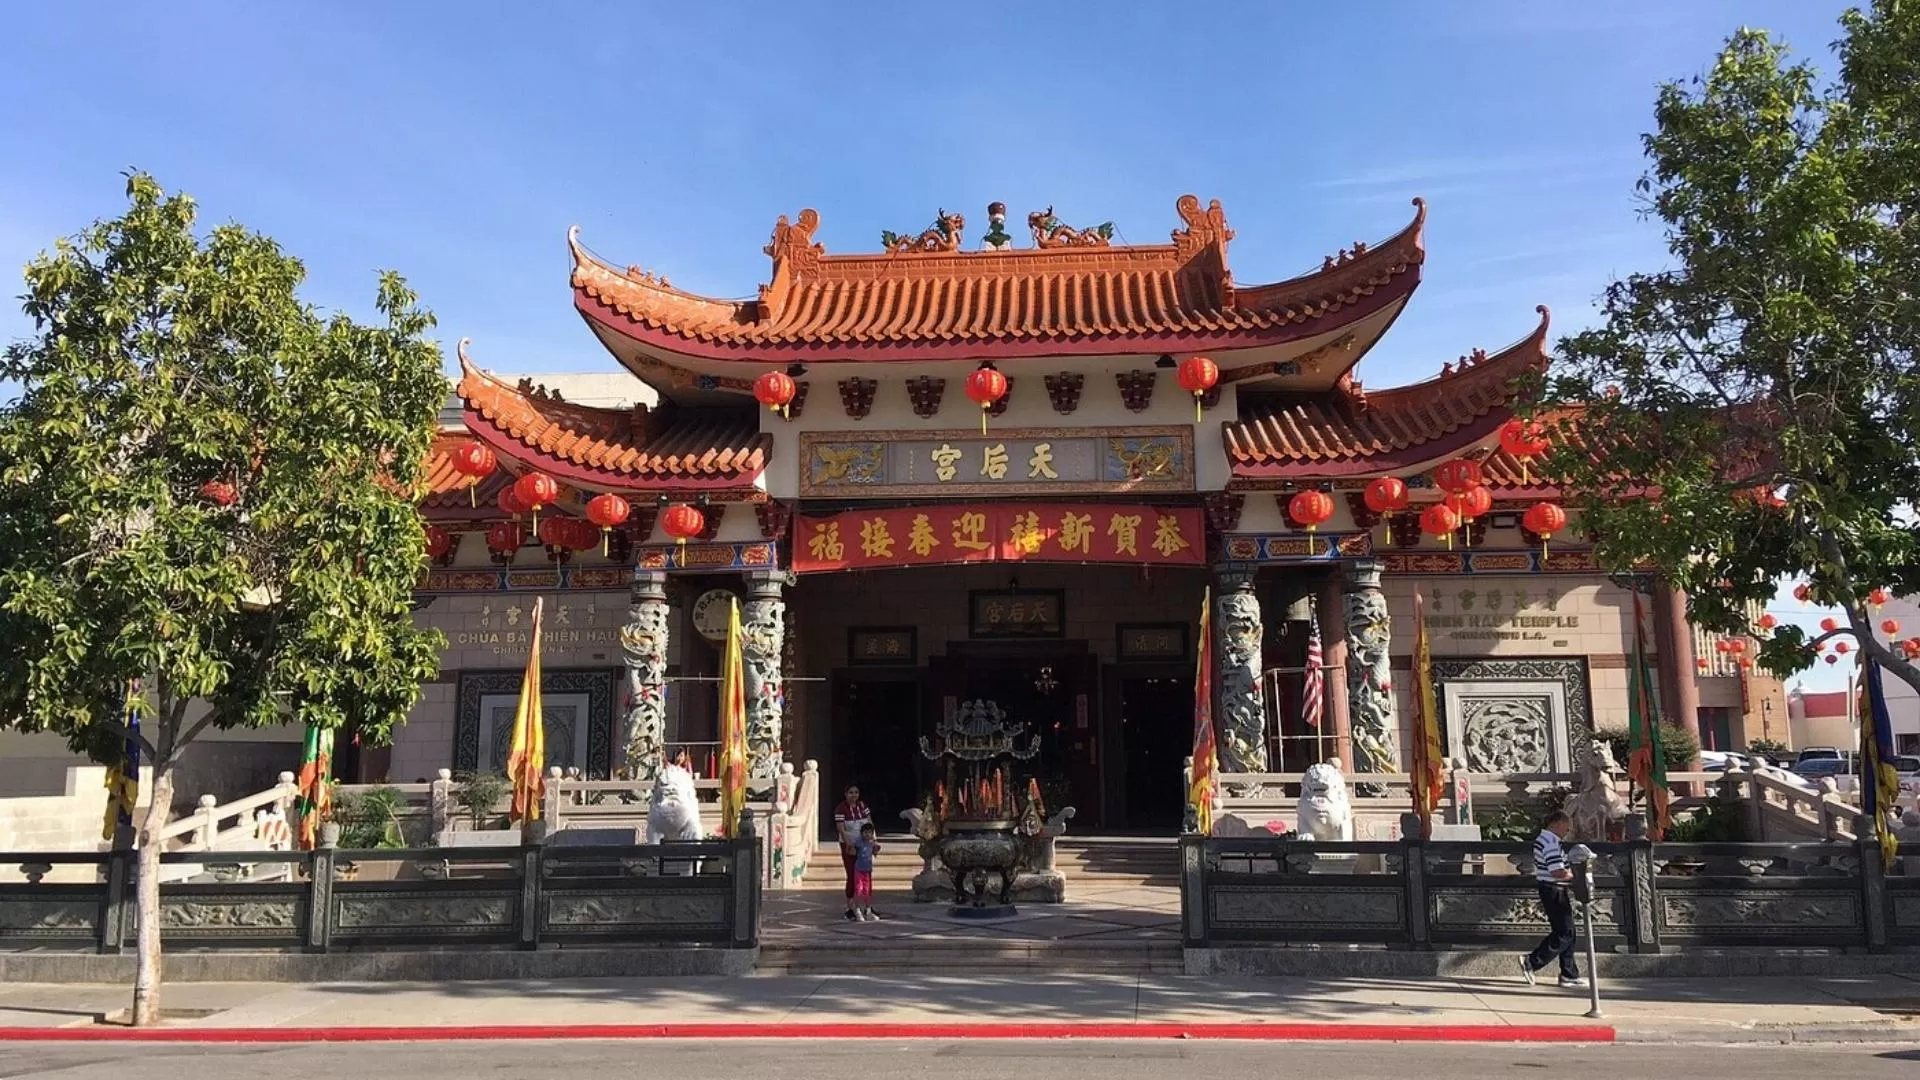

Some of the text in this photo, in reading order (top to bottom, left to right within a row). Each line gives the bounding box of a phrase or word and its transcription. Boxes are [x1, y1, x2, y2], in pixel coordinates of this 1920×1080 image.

[931, 443, 1058, 482] 天后宮
[1511, 615, 1579, 628] TEMPLE
